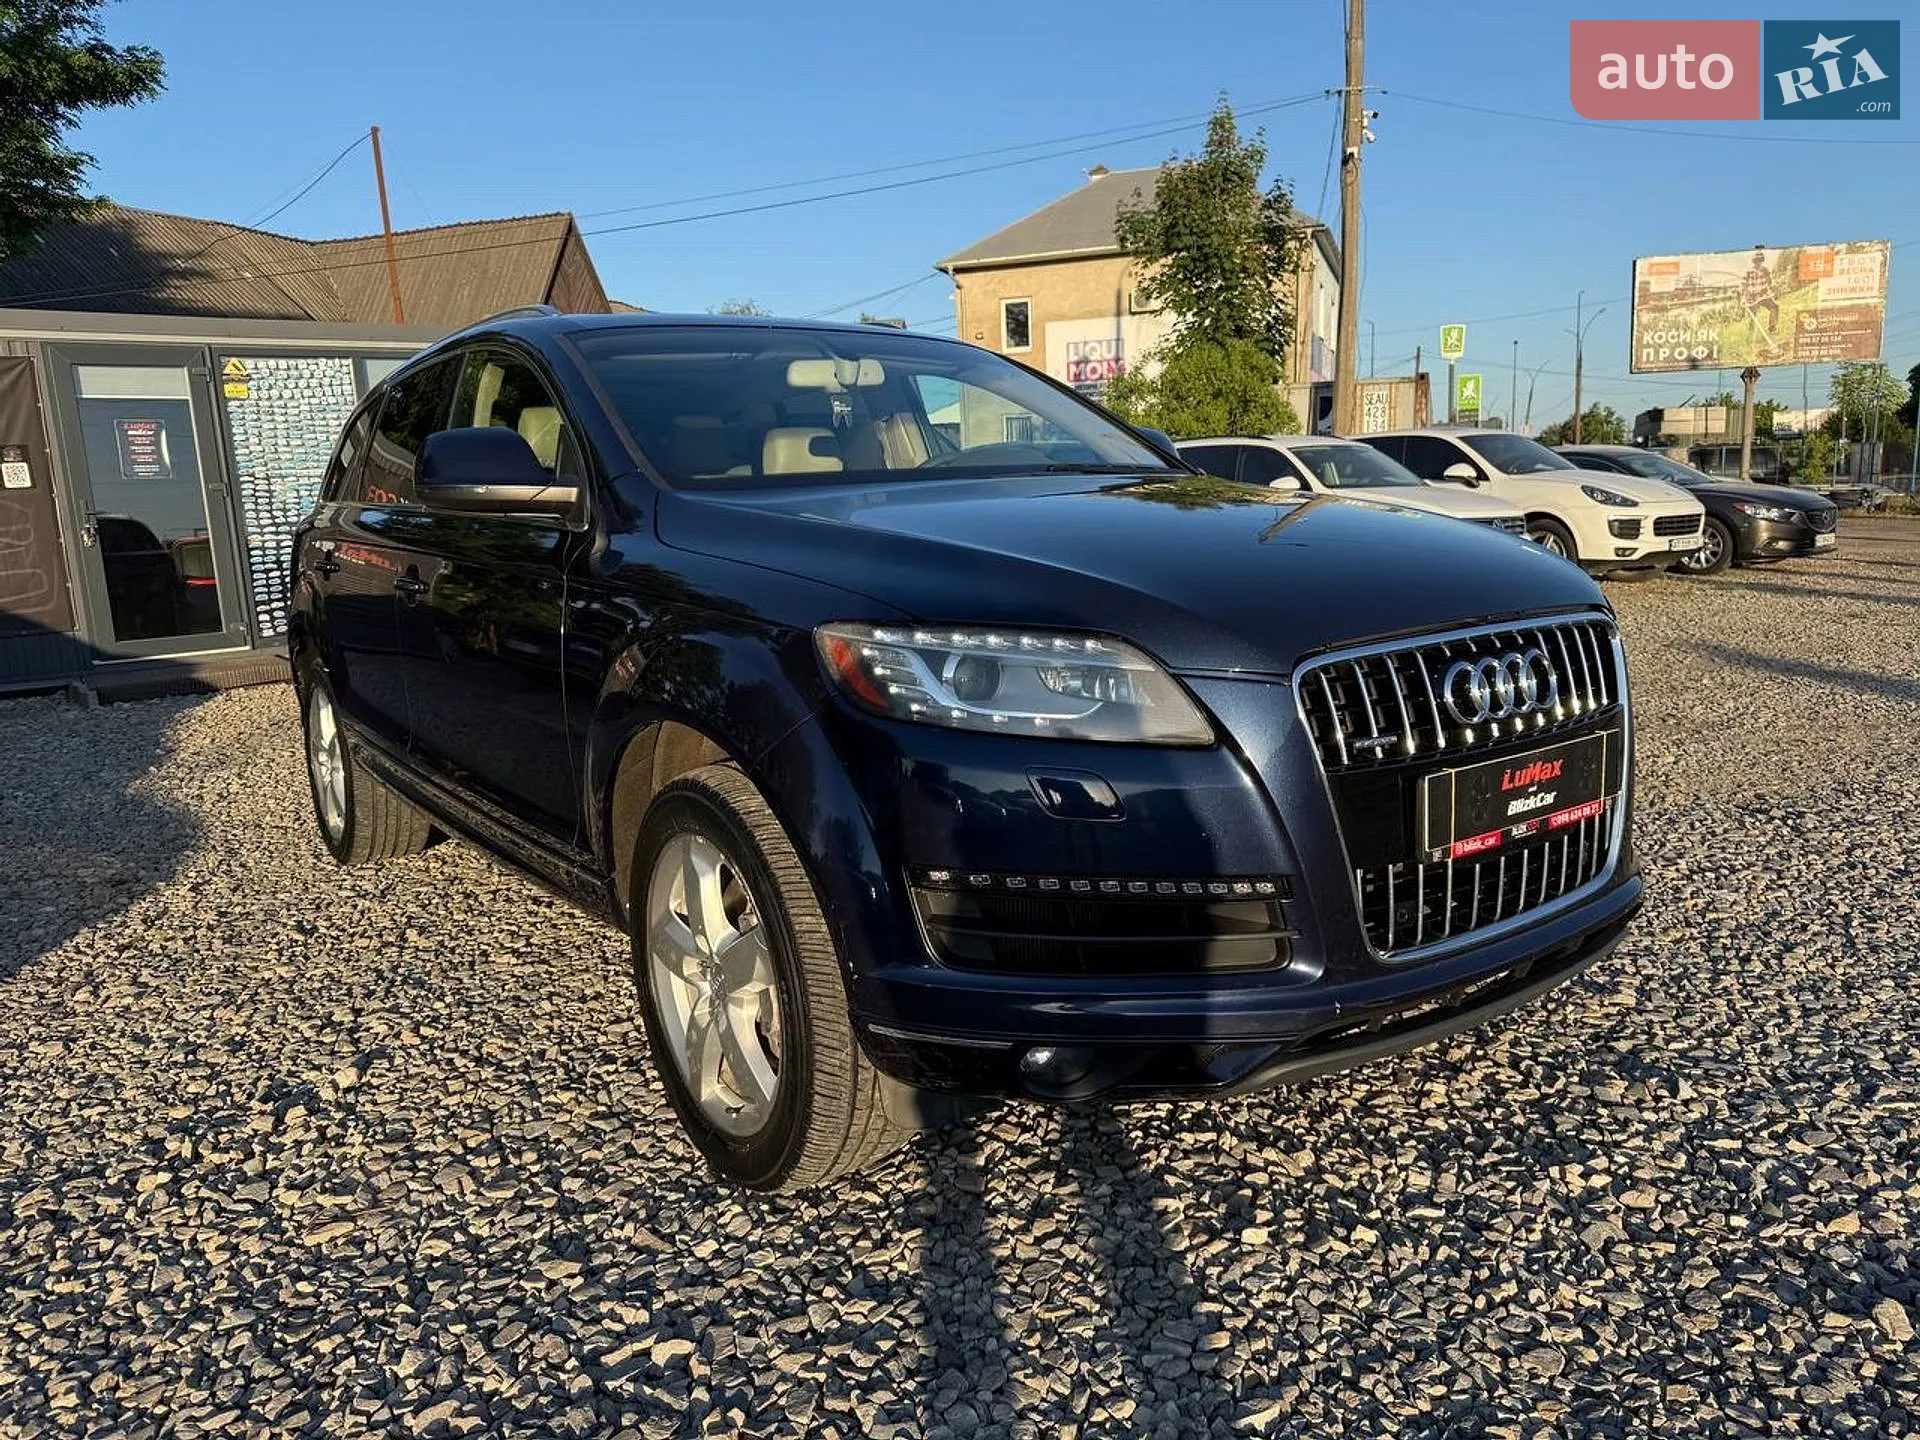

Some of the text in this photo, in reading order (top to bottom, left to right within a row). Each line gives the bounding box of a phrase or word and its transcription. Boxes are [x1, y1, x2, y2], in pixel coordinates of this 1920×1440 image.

[1643, 328, 1719, 345] КОСИ ЯК
[1068, 341, 1122, 361] LIQUI
[1068, 361, 1124, 380] MOLY
[1365, 392, 1389, 405] SEAU
[1365, 406, 1387, 418] 428
[1502, 759, 1563, 791] LuMax
